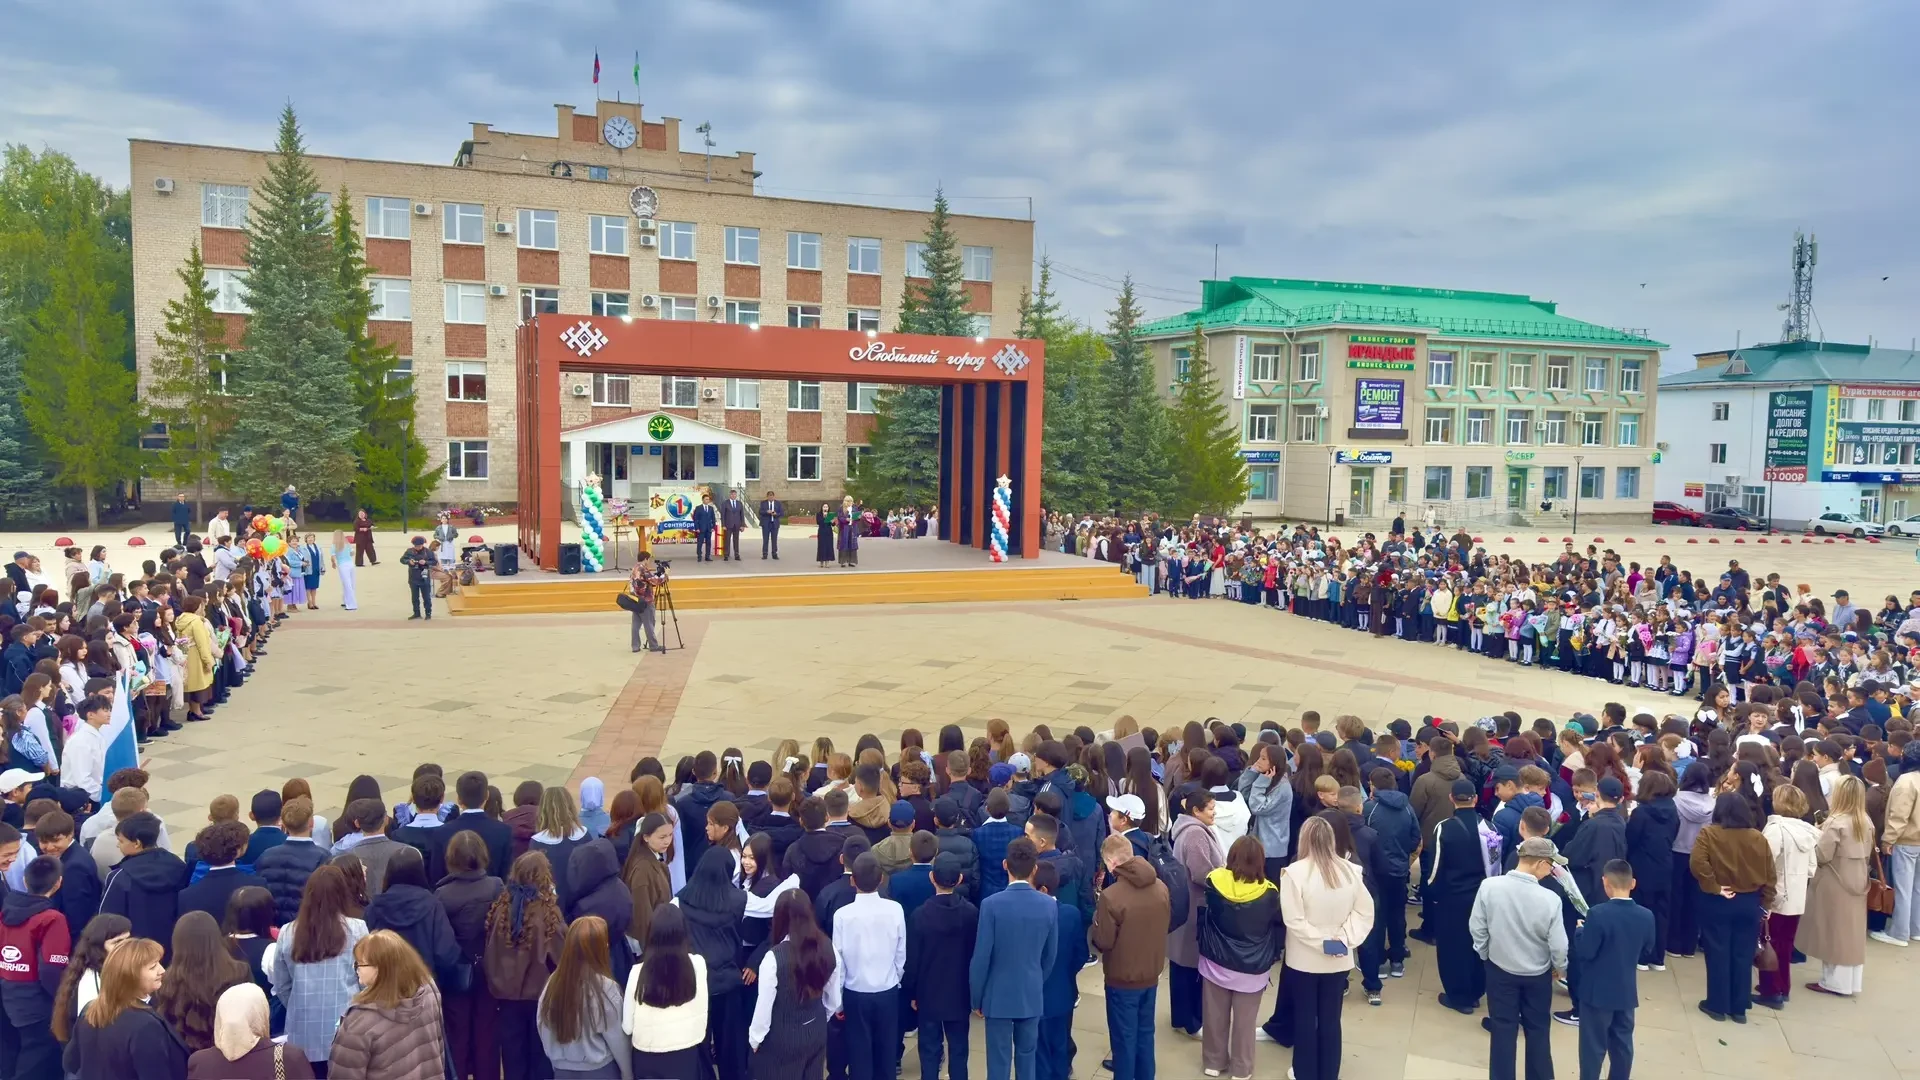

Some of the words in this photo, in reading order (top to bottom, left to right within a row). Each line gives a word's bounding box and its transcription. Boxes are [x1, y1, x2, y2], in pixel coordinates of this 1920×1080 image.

[849, 341, 940, 364] Любимый
[946, 352, 986, 371] город
[1349, 344, 1416, 362] ИРАНДЫК
[1357, 361, 1407, 369] БИЗНЕС-ЦЕНТР
[1360, 388, 1399, 401] РЕМОНТ
[1841, 387, 1906, 397] Туристическое
[1773, 408, 1806, 417] СПИСАНИЕ
[1776, 418, 1802, 428] ДОЛГОВ
[1769, 428, 1774, 437] И
[1775, 428, 1808, 438] КРЕДИТОВ
[1515, 452, 1535, 460] СБЕР
[675, 498, 683, 515] 1
